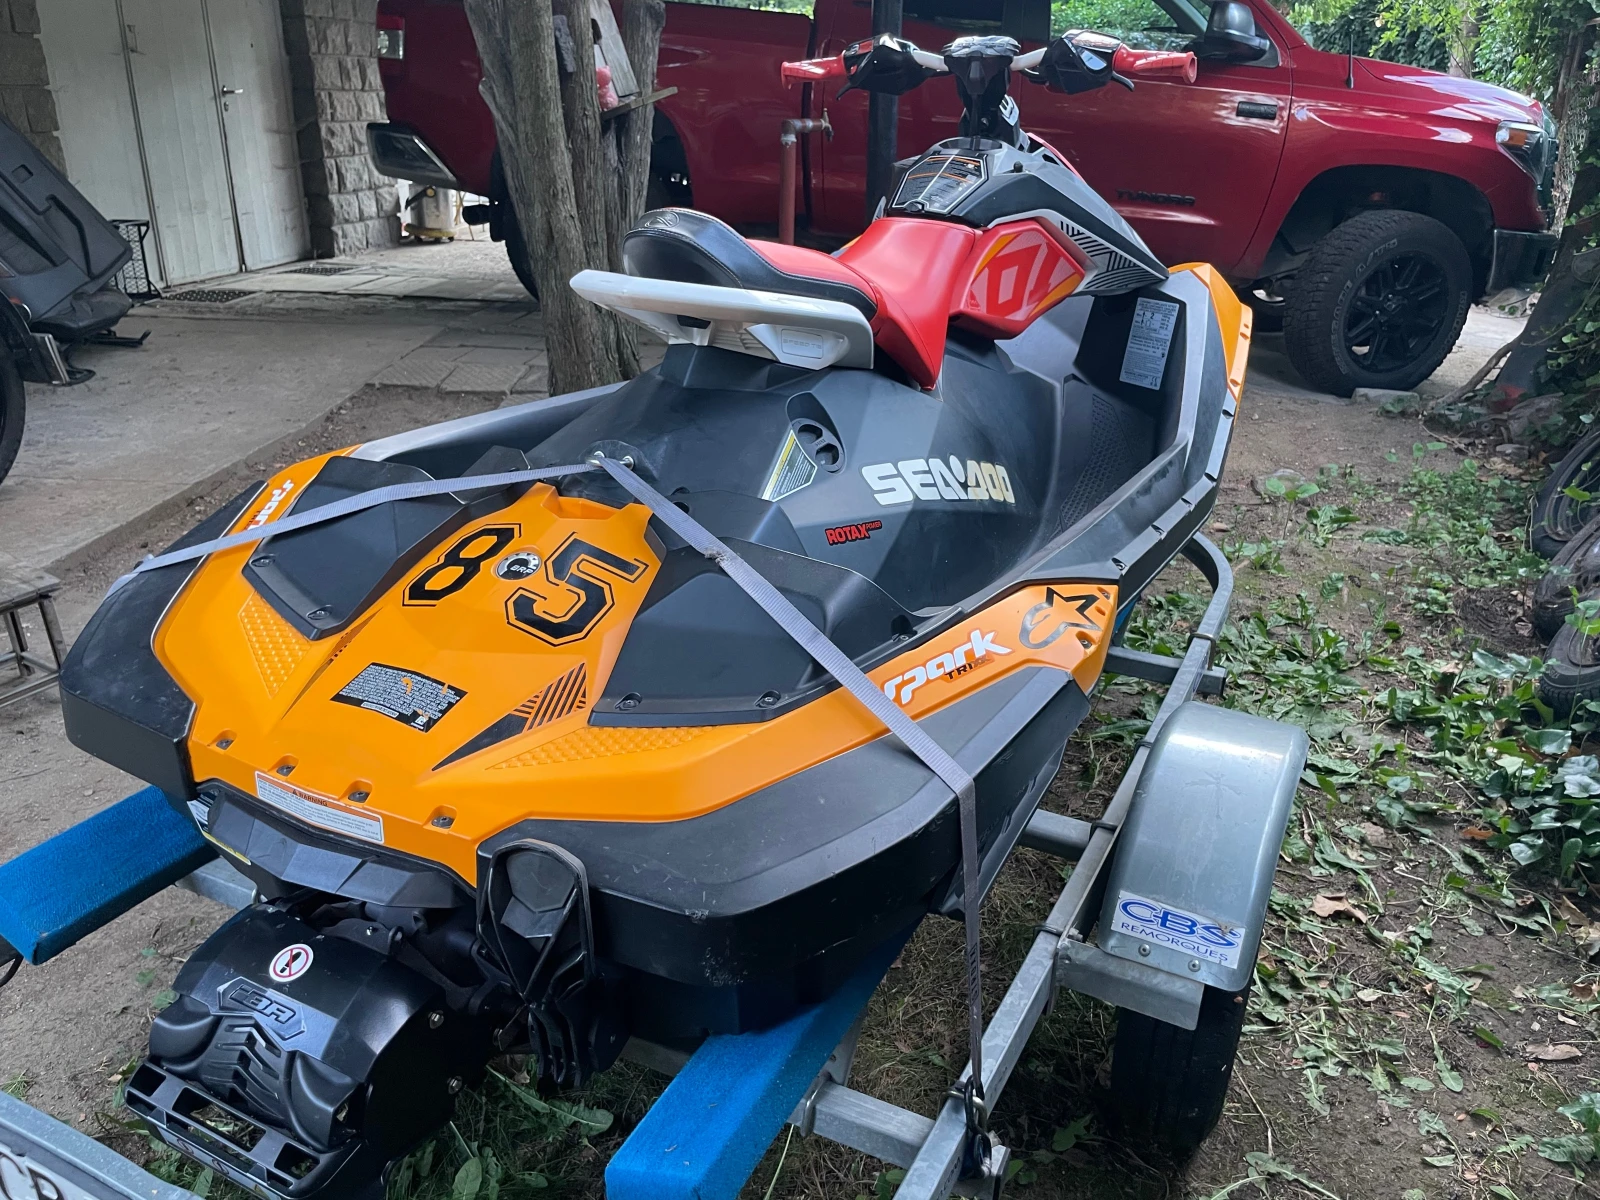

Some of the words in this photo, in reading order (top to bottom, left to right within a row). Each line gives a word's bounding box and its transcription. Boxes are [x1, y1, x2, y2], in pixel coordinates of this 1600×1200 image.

[1115, 188, 1196, 206] TUNDRA
[825, 523, 870, 545] ROTAX
[509, 563, 534, 574] BRP
[299, 791, 328, 806] WARNING
[1119, 898, 1242, 949] CBS
[1120, 921, 1229, 962] REMORQUES
